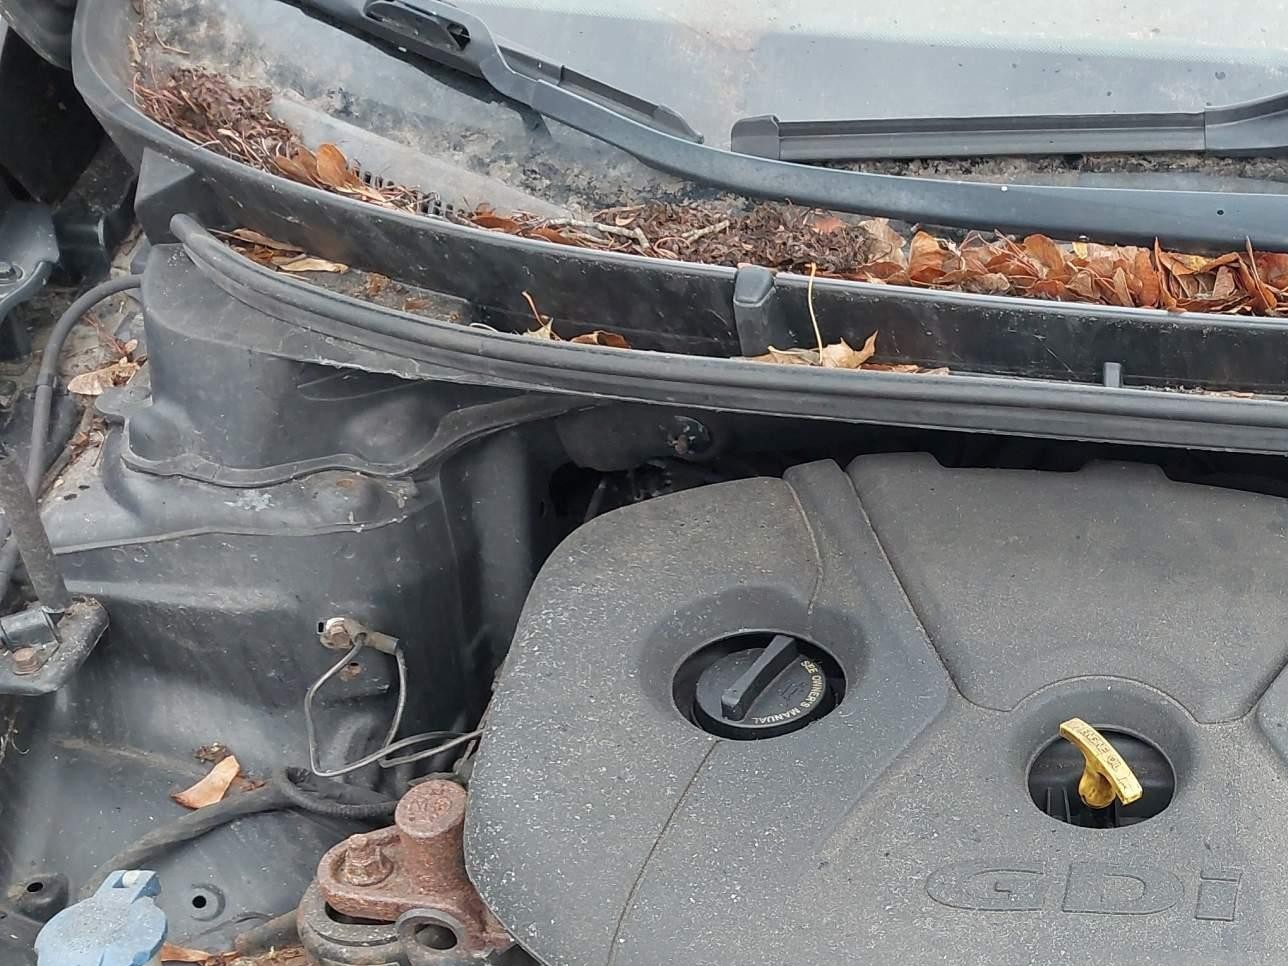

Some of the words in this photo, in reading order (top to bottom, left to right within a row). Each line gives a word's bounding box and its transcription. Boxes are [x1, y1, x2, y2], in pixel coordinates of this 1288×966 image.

[800, 660, 819, 674] SEE
[799, 674, 824, 708] OWNER'S
[751, 707, 801, 725] MANUAL
